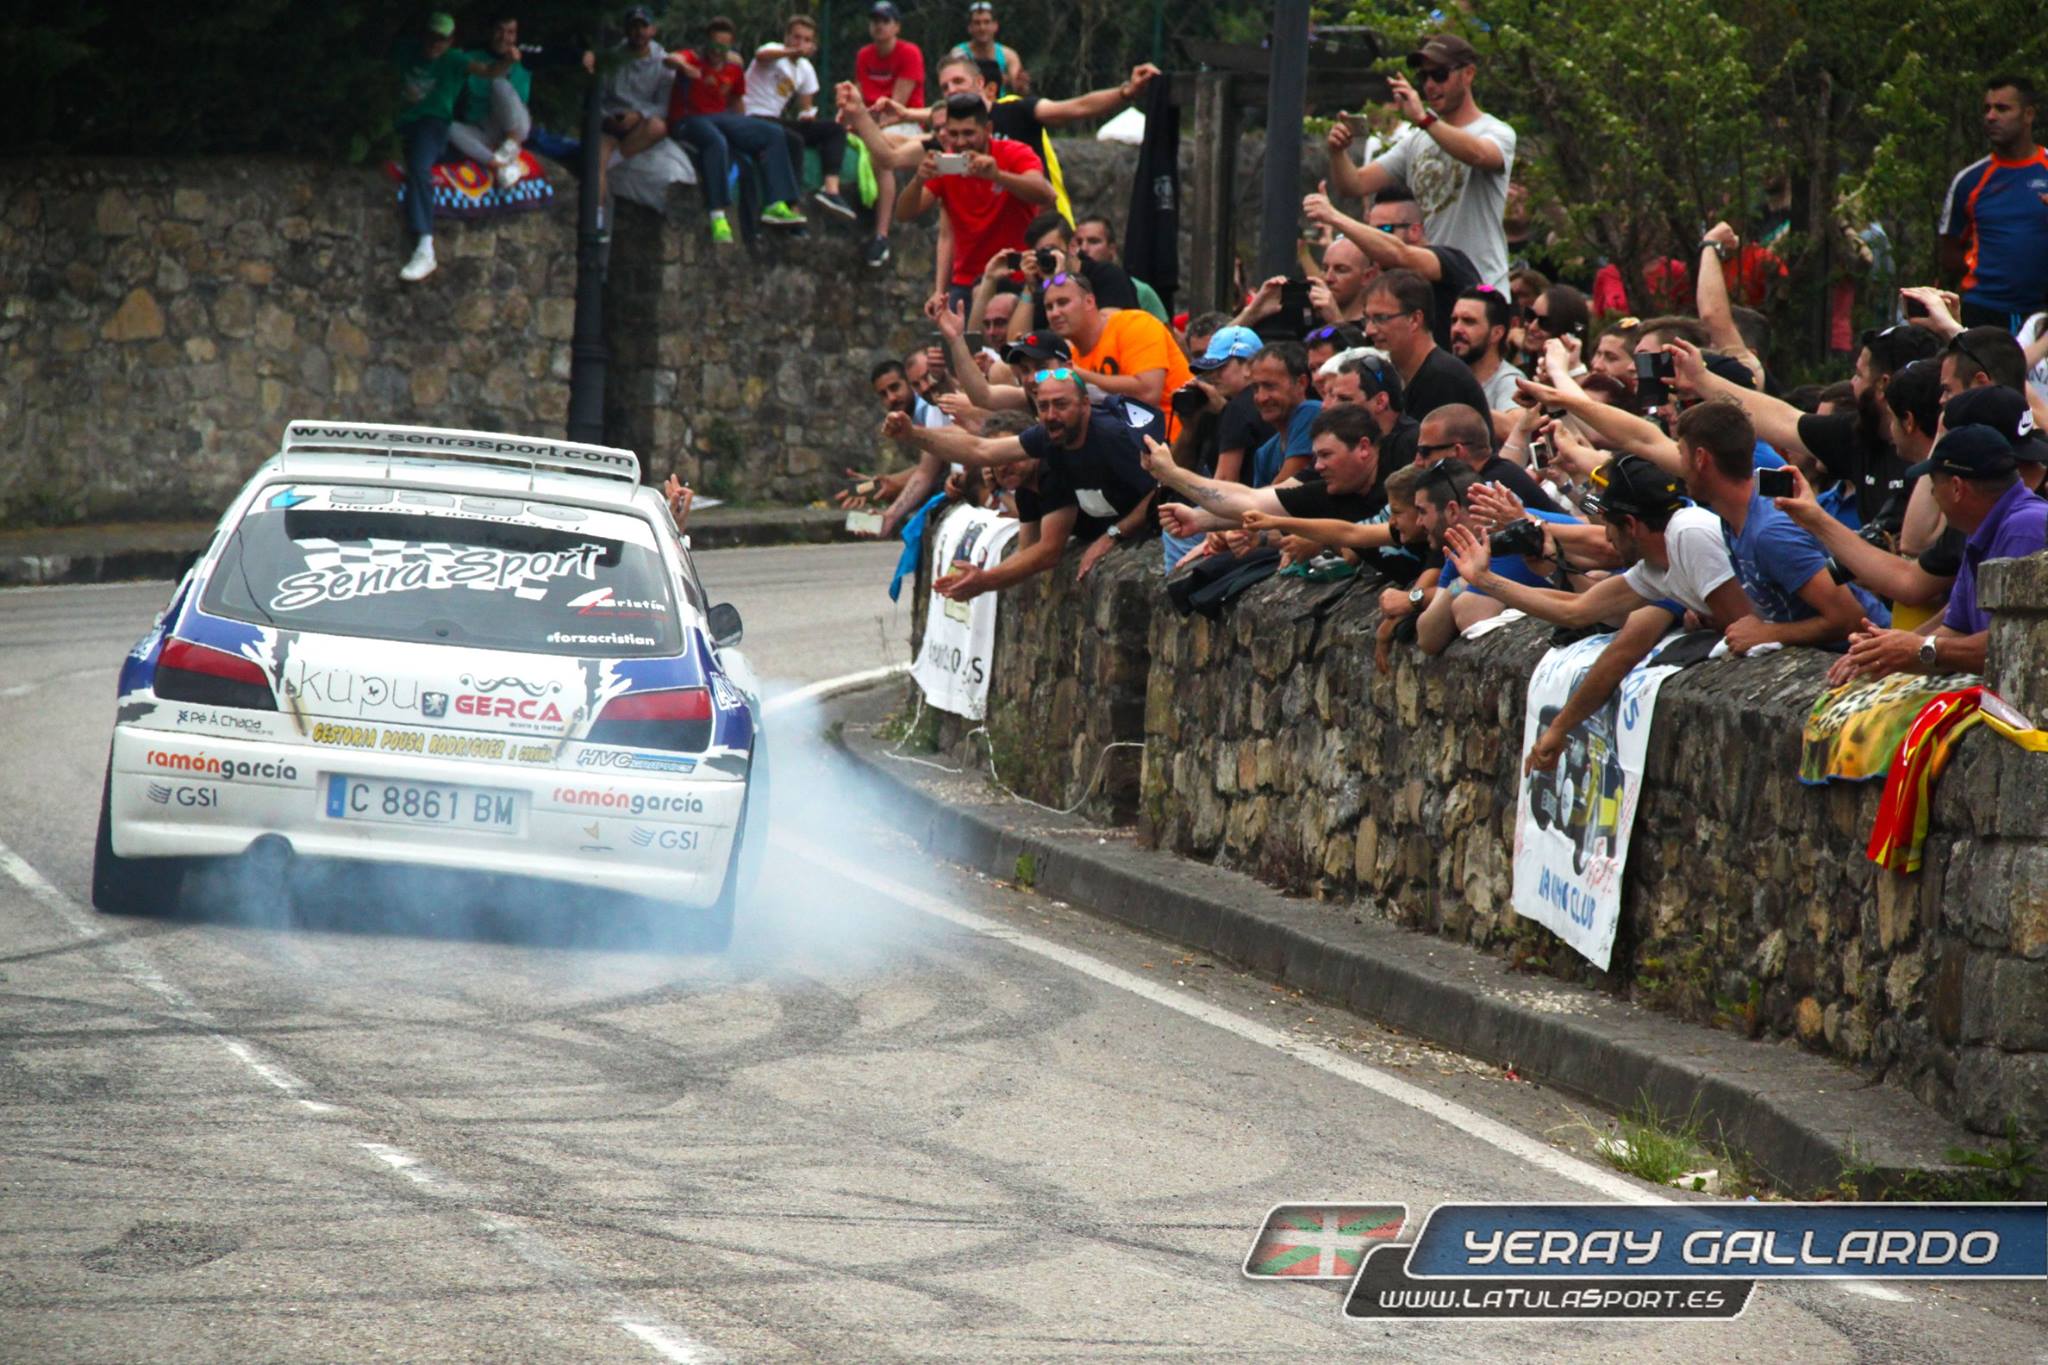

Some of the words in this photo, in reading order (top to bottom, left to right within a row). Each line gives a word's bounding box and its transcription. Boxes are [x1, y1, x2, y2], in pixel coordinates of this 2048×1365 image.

[292, 426, 635, 468] www.senrasport.com
[271, 557, 431, 611] Senra
[446, 543, 607, 590] Sport
[220, 714, 263, 731] Chapa
[455, 693, 563, 723] GERCA
[312, 721, 377, 749] GESTORIA
[381, 729, 425, 753] POUSA
[428, 732, 506, 760] RODRIGUEZ
[146, 749, 298, 780] ramóngarcía
[576, 749, 634, 769] HVC
[176, 786, 218, 808] GSI
[350, 783, 370, 812] C
[382, 785, 459, 821] 8861
[473, 793, 514, 825] BM
[552, 786, 703, 815] ramóngarcía
[658, 829, 699, 850] GSI
